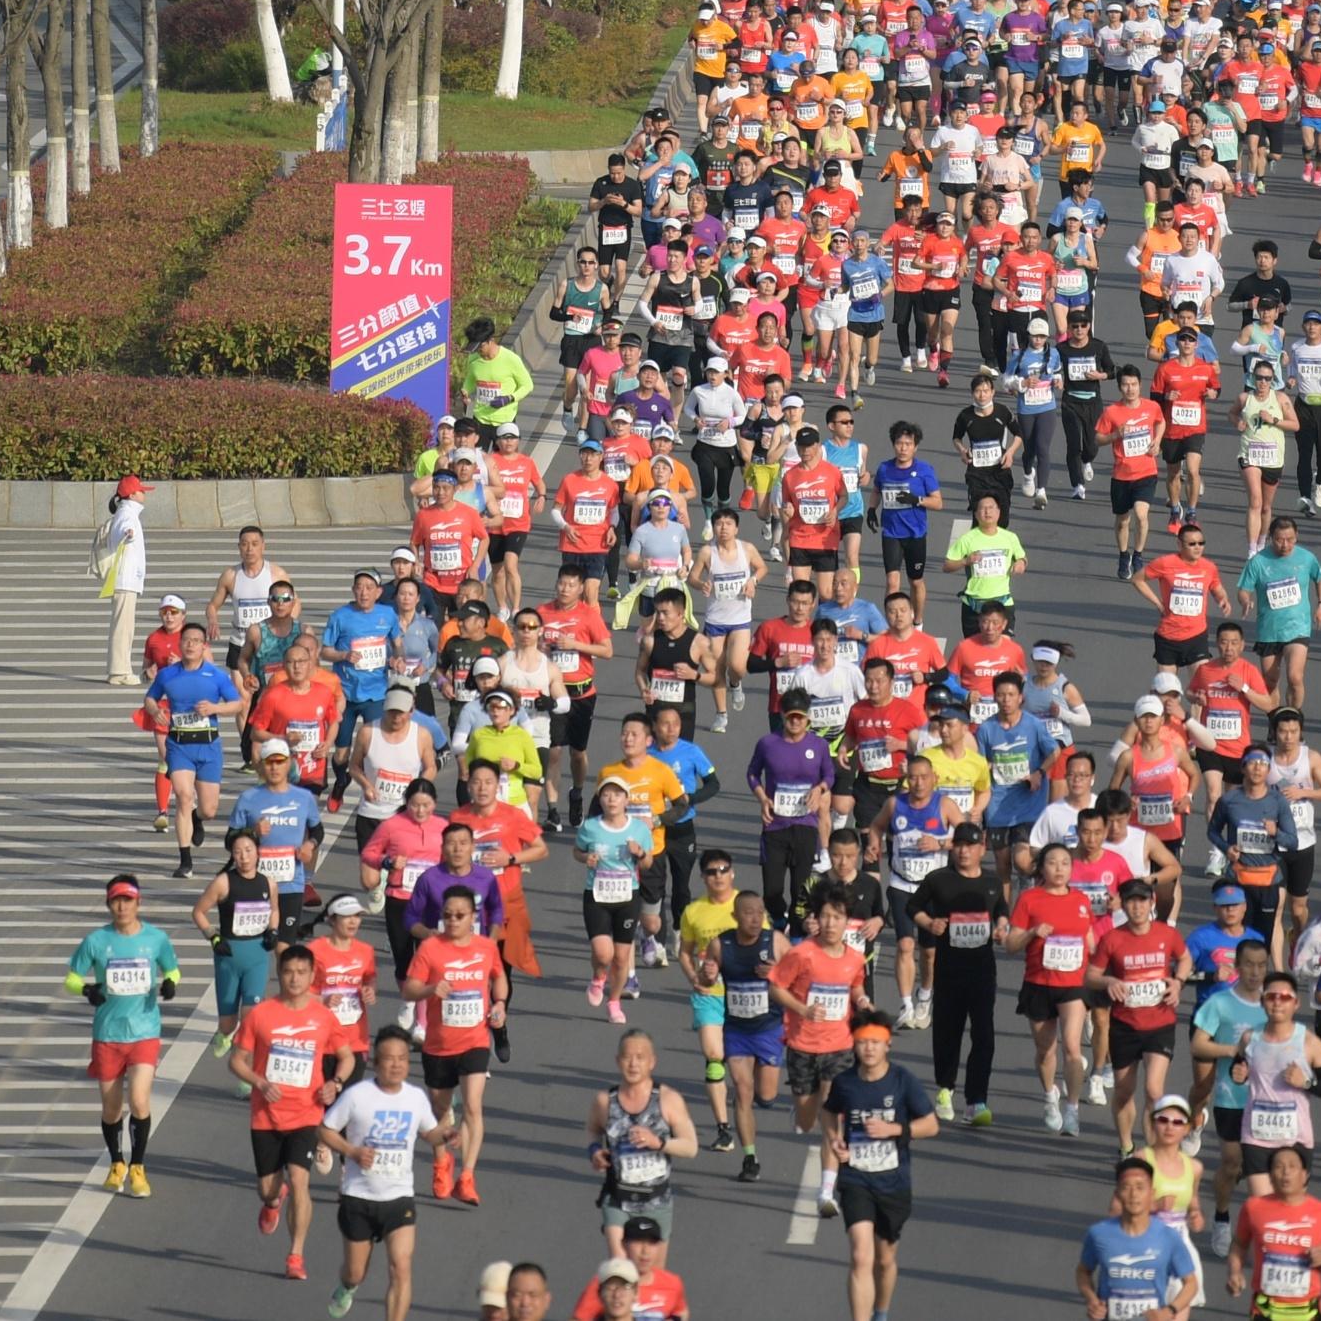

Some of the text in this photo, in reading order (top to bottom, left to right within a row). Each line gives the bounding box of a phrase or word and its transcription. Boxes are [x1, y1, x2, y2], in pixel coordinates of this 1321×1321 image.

[361, 199, 426, 216] 三七互娱
[1016, 271, 1042, 279] ERKE
[337, 293, 420, 348] 三分颜值
[357, 321, 438, 372] 七分坚持
[796, 489, 825, 498] ERKE
[430, 532, 461, 540] ERKE
[1174, 580, 1203, 589] ERKE
[544, 631, 575, 639] ERE
[260, 859, 291, 871] A0925
[112, 971, 145, 983] B4314
[444, 971, 483, 981] ERKE
[273, 1059, 308, 1074] B3547
[376, 1152, 403, 1165] 2840
[1264, 1233, 1311, 1246] ERKE
[1108, 1268, 1156, 1280] ERKE
